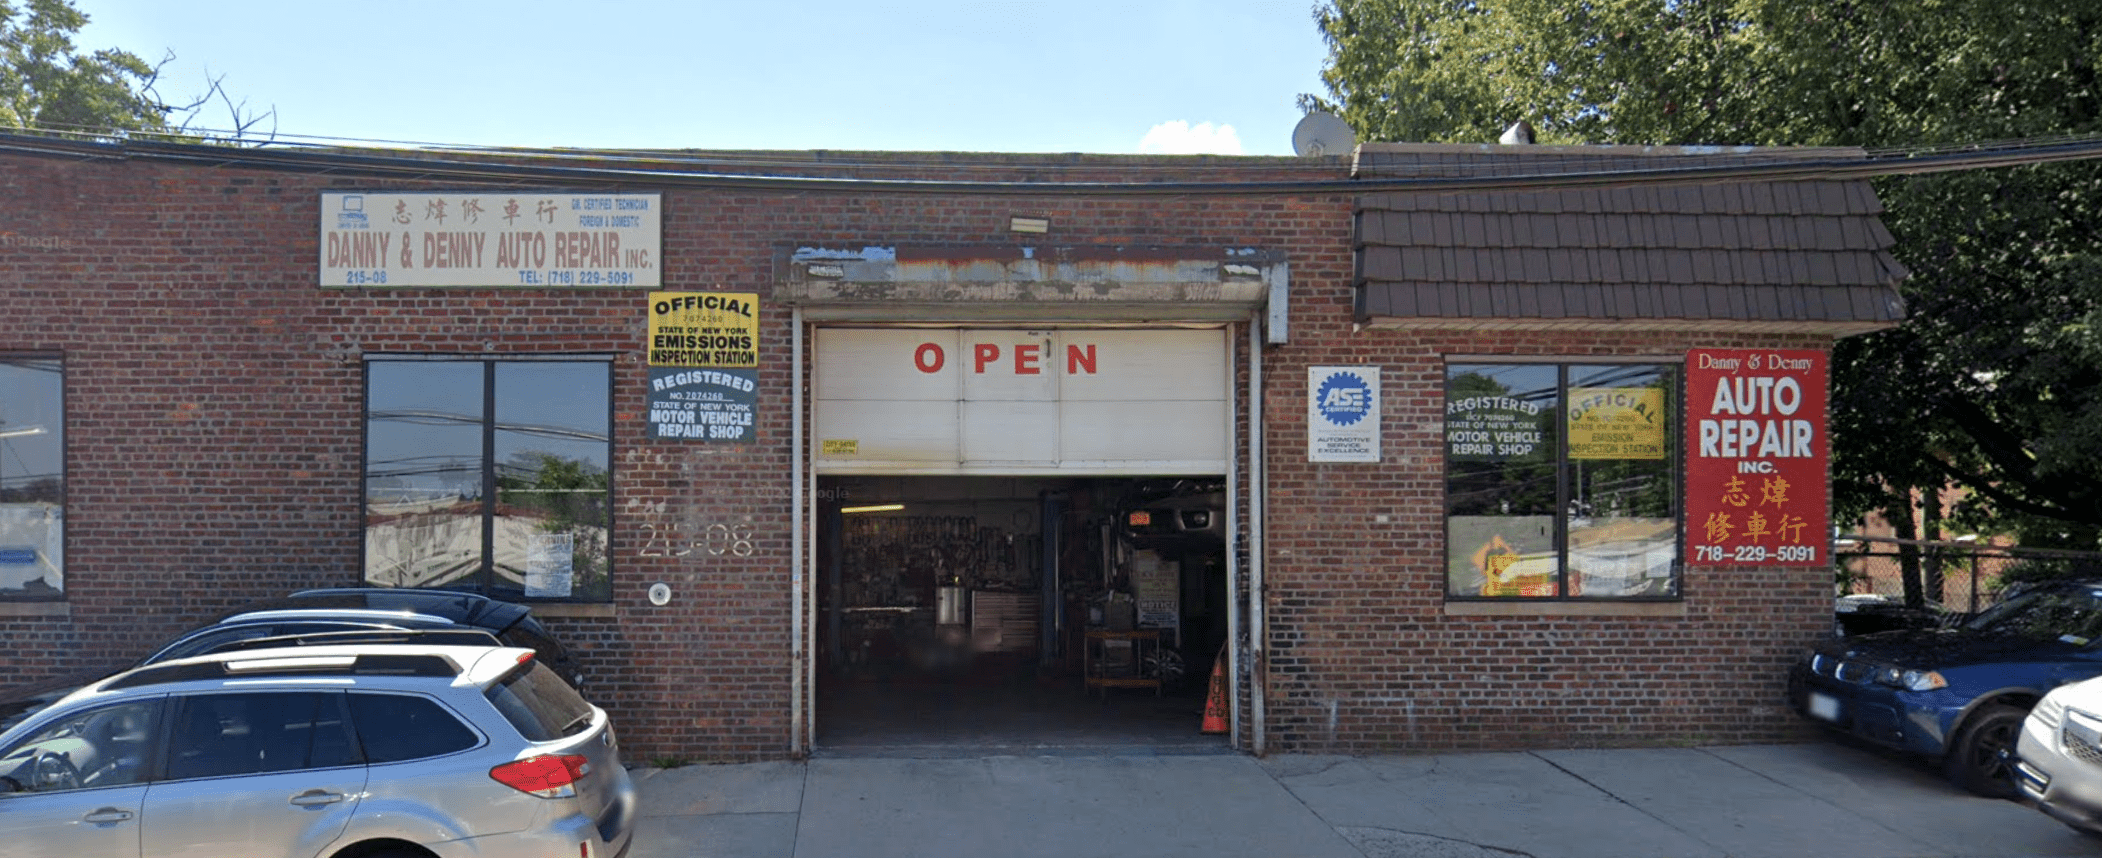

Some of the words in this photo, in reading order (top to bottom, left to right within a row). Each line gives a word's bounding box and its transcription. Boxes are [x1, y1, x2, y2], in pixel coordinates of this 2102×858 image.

[584, 198, 612, 210] CERTIFIED
[615, 198, 648, 210] TECHNICIAN
[580, 215, 603, 227] FOREIGN
[612, 215, 639, 227] DOMESTIC
[328, 231, 390, 268] DANNY
[401, 231, 413, 268] &
[424, 231, 485, 268] DENNY
[496, 231, 546, 268] AUTO
[555, 231, 620, 268] REPAIR
[625, 249, 653, 269] INC.
[347, 270, 387, 283] 215-08
[519, 270, 543, 283] TEL:
[548, 270, 574, 284] (718)
[580, 270, 633, 284] 229-5091
[655, 296, 752, 317] OFFICIAL
[654, 335, 752, 349] EMISSIONS
[651, 350, 710, 363] INSPECTION
[715, 351, 755, 364] STATION
[914, 343, 1097, 375] OPEN
[1699, 353, 1741, 375] Danny
[1747, 354, 1761, 370] &
[1768, 354, 1813, 375] Denny
[653, 371, 754, 392] REGISTERED
[670, 392, 685, 400] NO.
[1324, 387, 1364, 406] ASE
[1710, 376, 1802, 415] AUTO
[653, 402, 680, 410] STATE
[684, 402, 697, 410] OF
[701, 403, 721, 411] NEW
[725, 404, 750, 412] YORK
[1447, 396, 1539, 415] REGISTERED
[1570, 394, 1654, 423] OFFICIAL
[651, 410, 695, 423] MOTOR
[700, 412, 752, 425] VEHICLE
[1473, 421, 1484, 429] OF
[1488, 421, 1509, 429] NEW
[658, 424, 704, 437] REPAIR
[709, 425, 744, 438] SHOP
[1494, 432, 1542, 443] VEHICLE
[1699, 419, 1813, 457] REPAIR
[1452, 443, 1494, 455] REPAIR
[1498, 444, 1533, 455] SHOP
[1738, 461, 1778, 473] INC.
[1721, 475, 1791, 509] 志煒
[1703, 511, 1808, 544] 修車行
[1695, 545, 1815, 562] 718-229-5091
